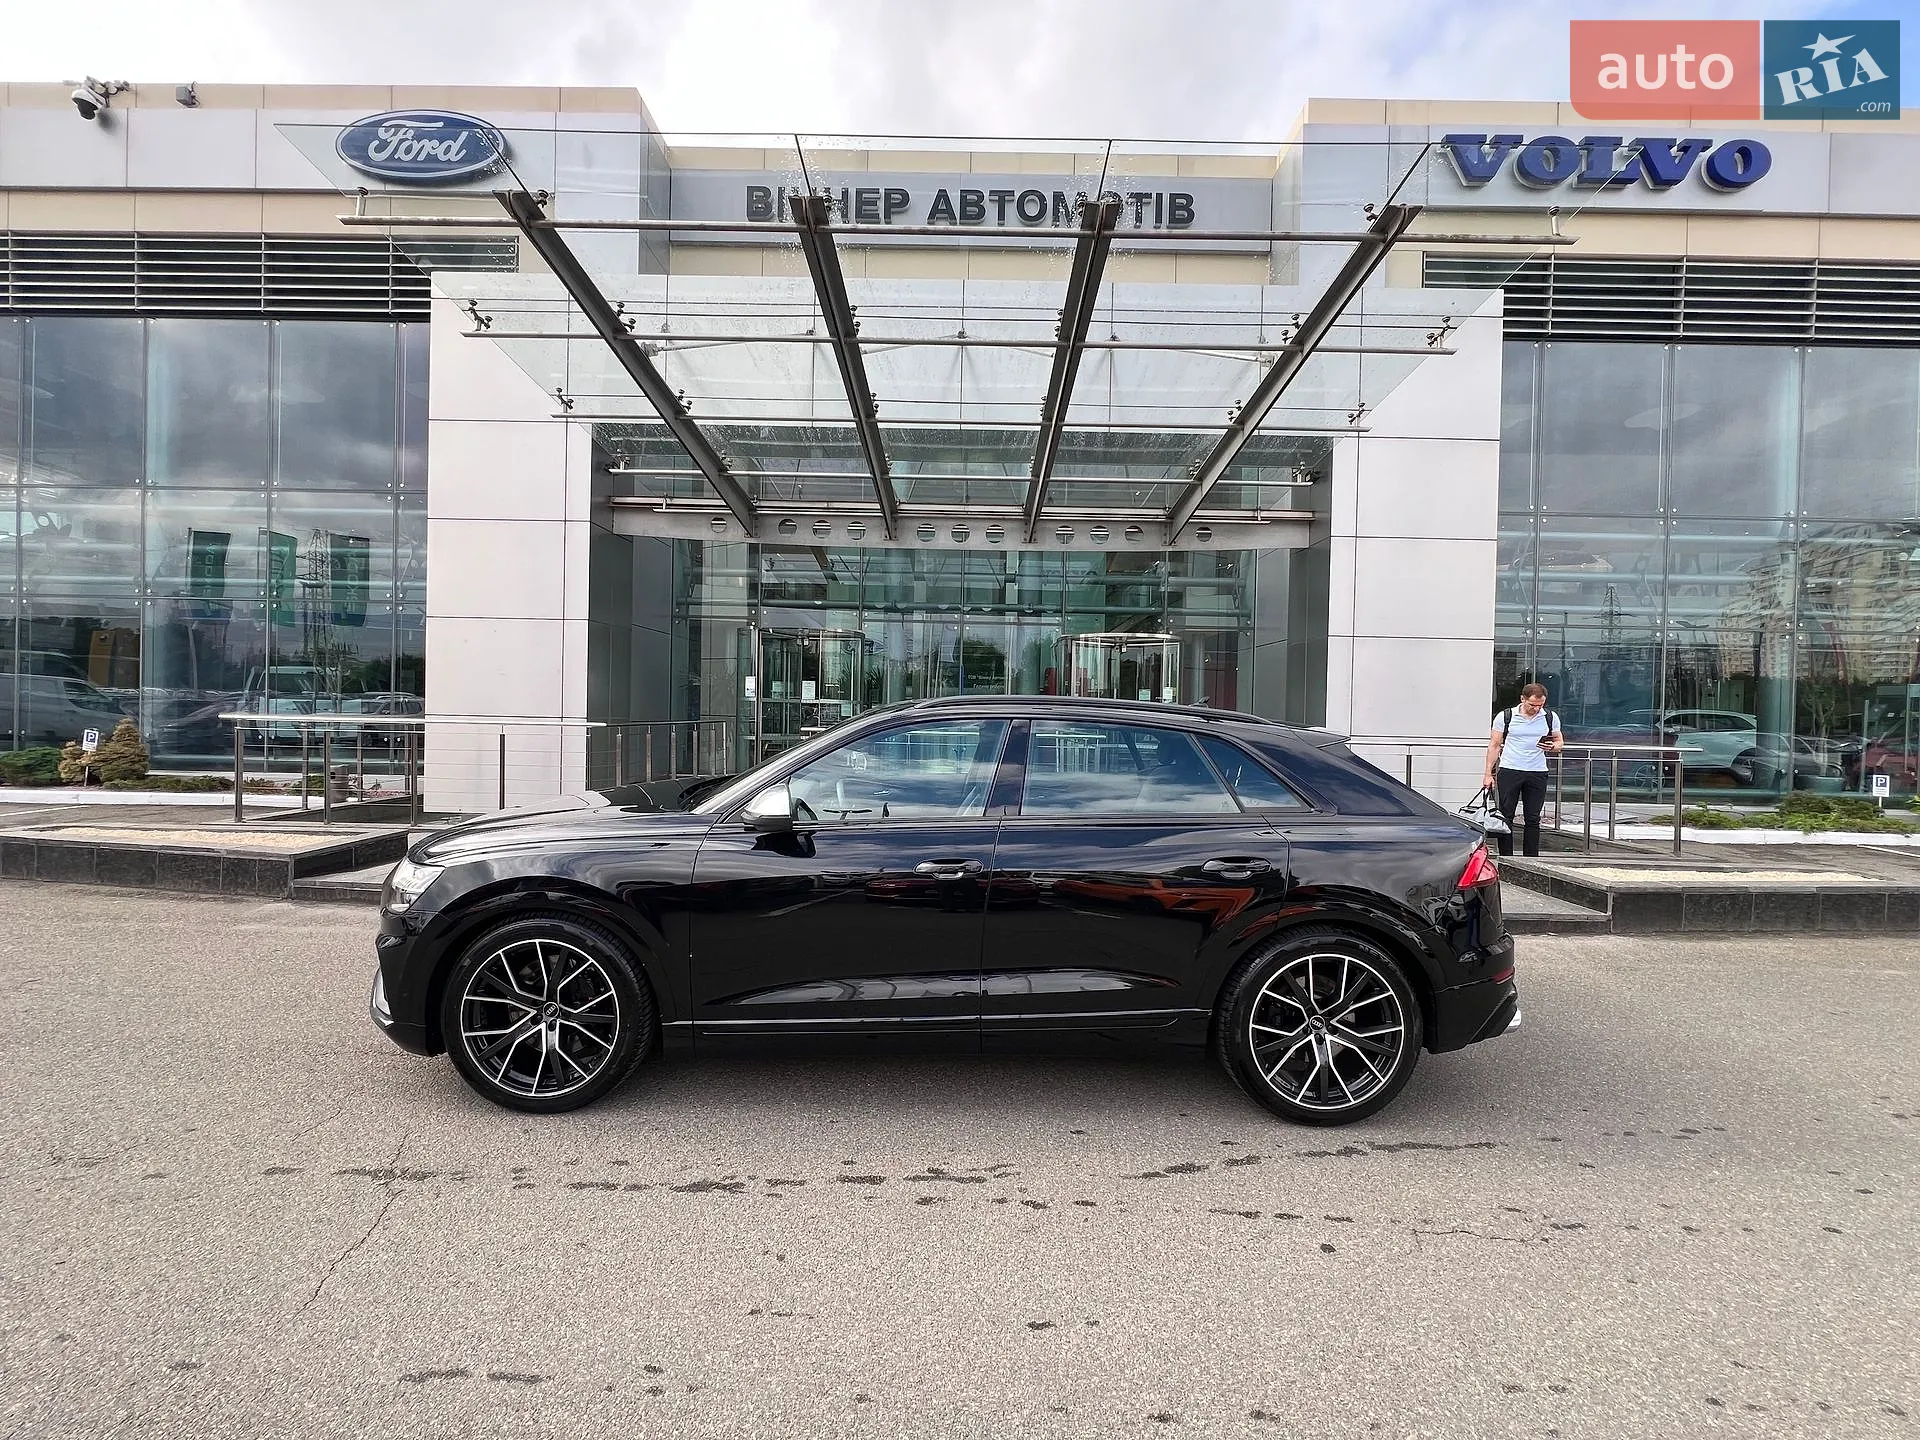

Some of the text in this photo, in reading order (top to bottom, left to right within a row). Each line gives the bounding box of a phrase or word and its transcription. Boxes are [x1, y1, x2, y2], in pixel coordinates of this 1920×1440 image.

[368, 119, 469, 162] Ford
[1441, 133, 1772, 190] VOLVO
[746, 185, 912, 224] ВІНЕР
